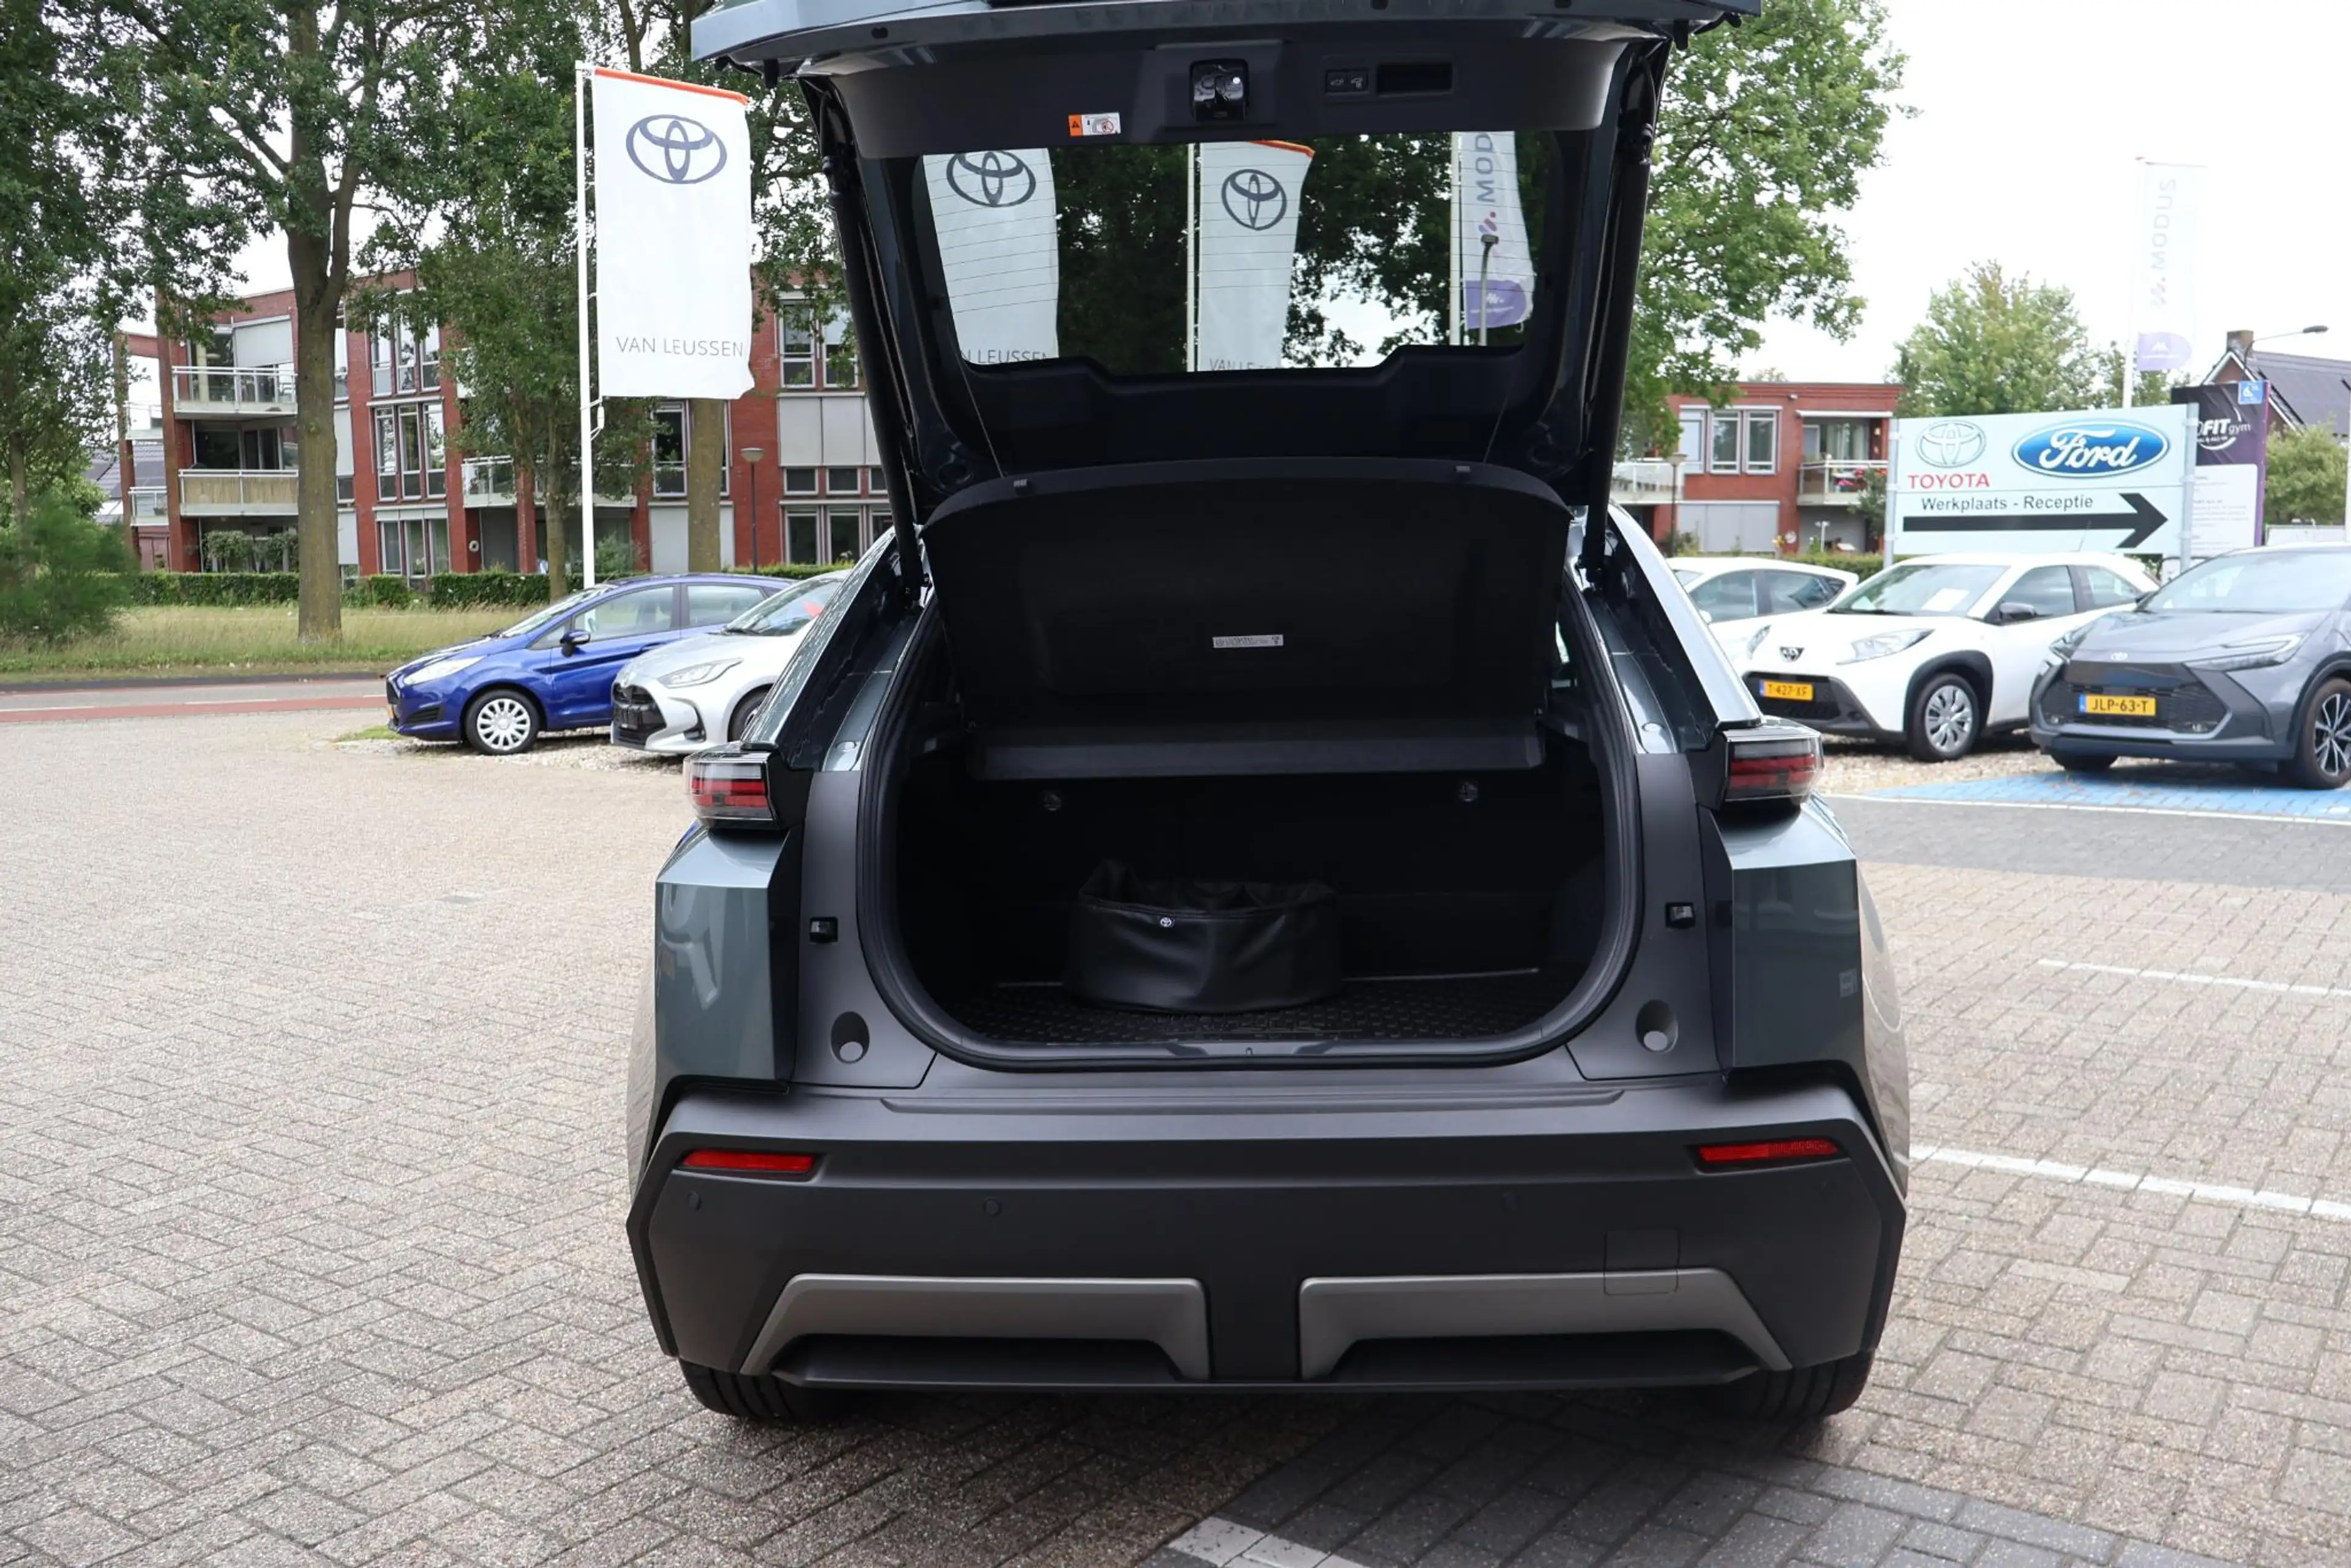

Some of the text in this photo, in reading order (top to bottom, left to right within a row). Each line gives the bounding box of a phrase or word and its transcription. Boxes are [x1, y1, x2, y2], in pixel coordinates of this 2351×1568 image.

[2151, 178, 2177, 270] MODUS
[615, 336, 743, 358] VAN LEUSSEN
[2039, 428, 2141, 469] Ford
[1907, 473, 1990, 489] TOYOTA
[1921, 497, 2008, 513] Werkplaats
[2023, 495, 2094, 511] Receptie
[2091, 698, 2148, 713] JLP-63-T
